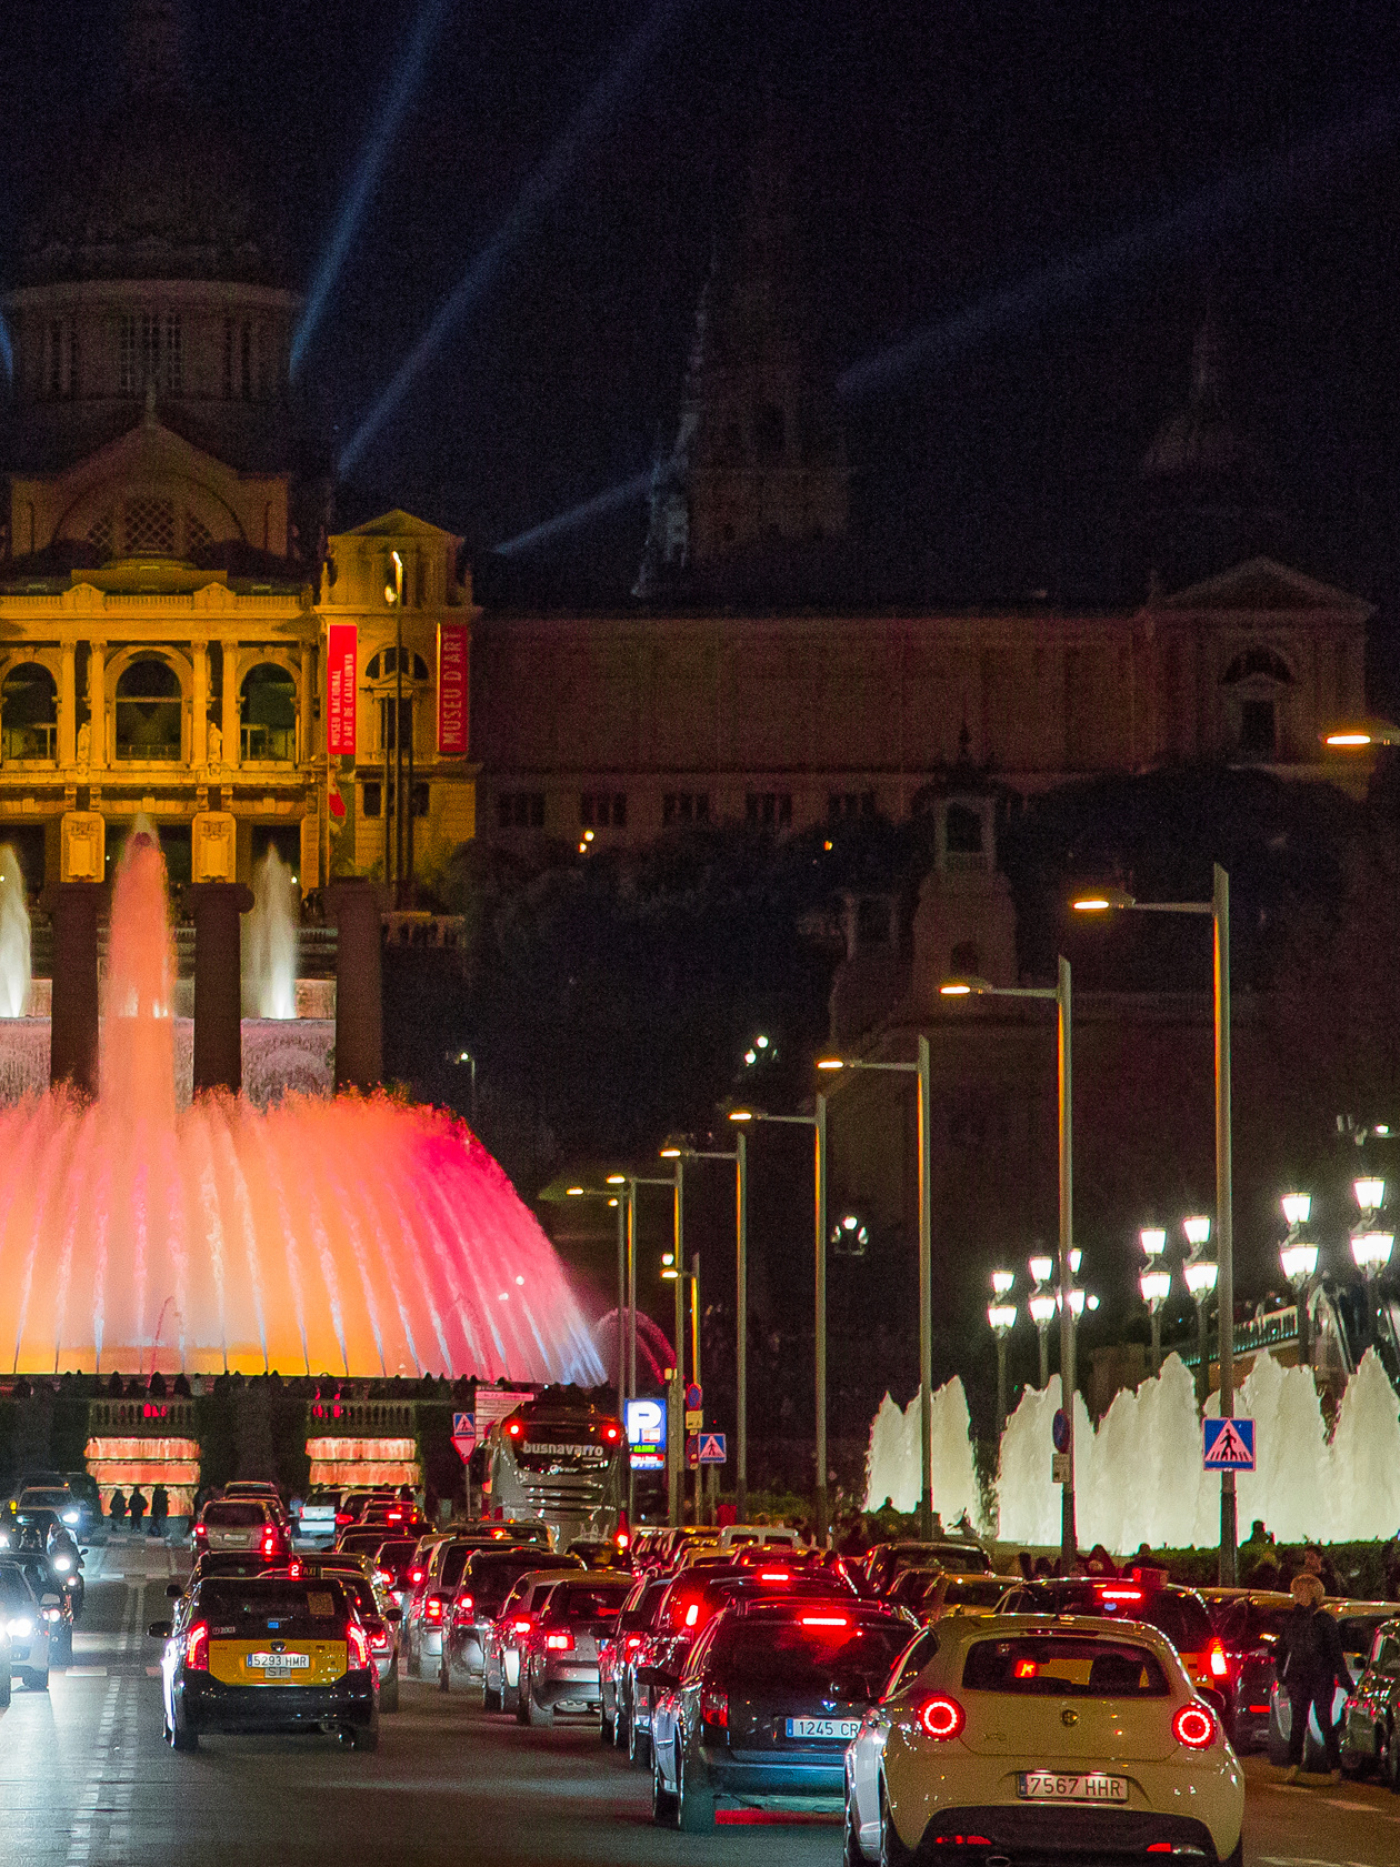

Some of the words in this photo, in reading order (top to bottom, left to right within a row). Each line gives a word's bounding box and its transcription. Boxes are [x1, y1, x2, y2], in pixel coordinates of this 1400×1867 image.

[442, 632, 462, 681] D'ART
[344, 654, 354, 704] CATALUNYA
[331, 670, 341, 714] NACIONAL
[344, 706, 354, 718] DE
[442, 688, 462, 745] MUSEU
[331, 717, 341, 746] MUSEU
[627, 1401, 662, 1444] P
[522, 1440, 604, 1457] busnavarro
[290, 1564, 300, 1576] 2
[254, 1655, 282, 1667] 5293
[285, 1656, 308, 1668] HMR
[799, 1721, 834, 1736] 1245
[1030, 1777, 1079, 1794] 7567
[1085, 1779, 1121, 1797] HHR
